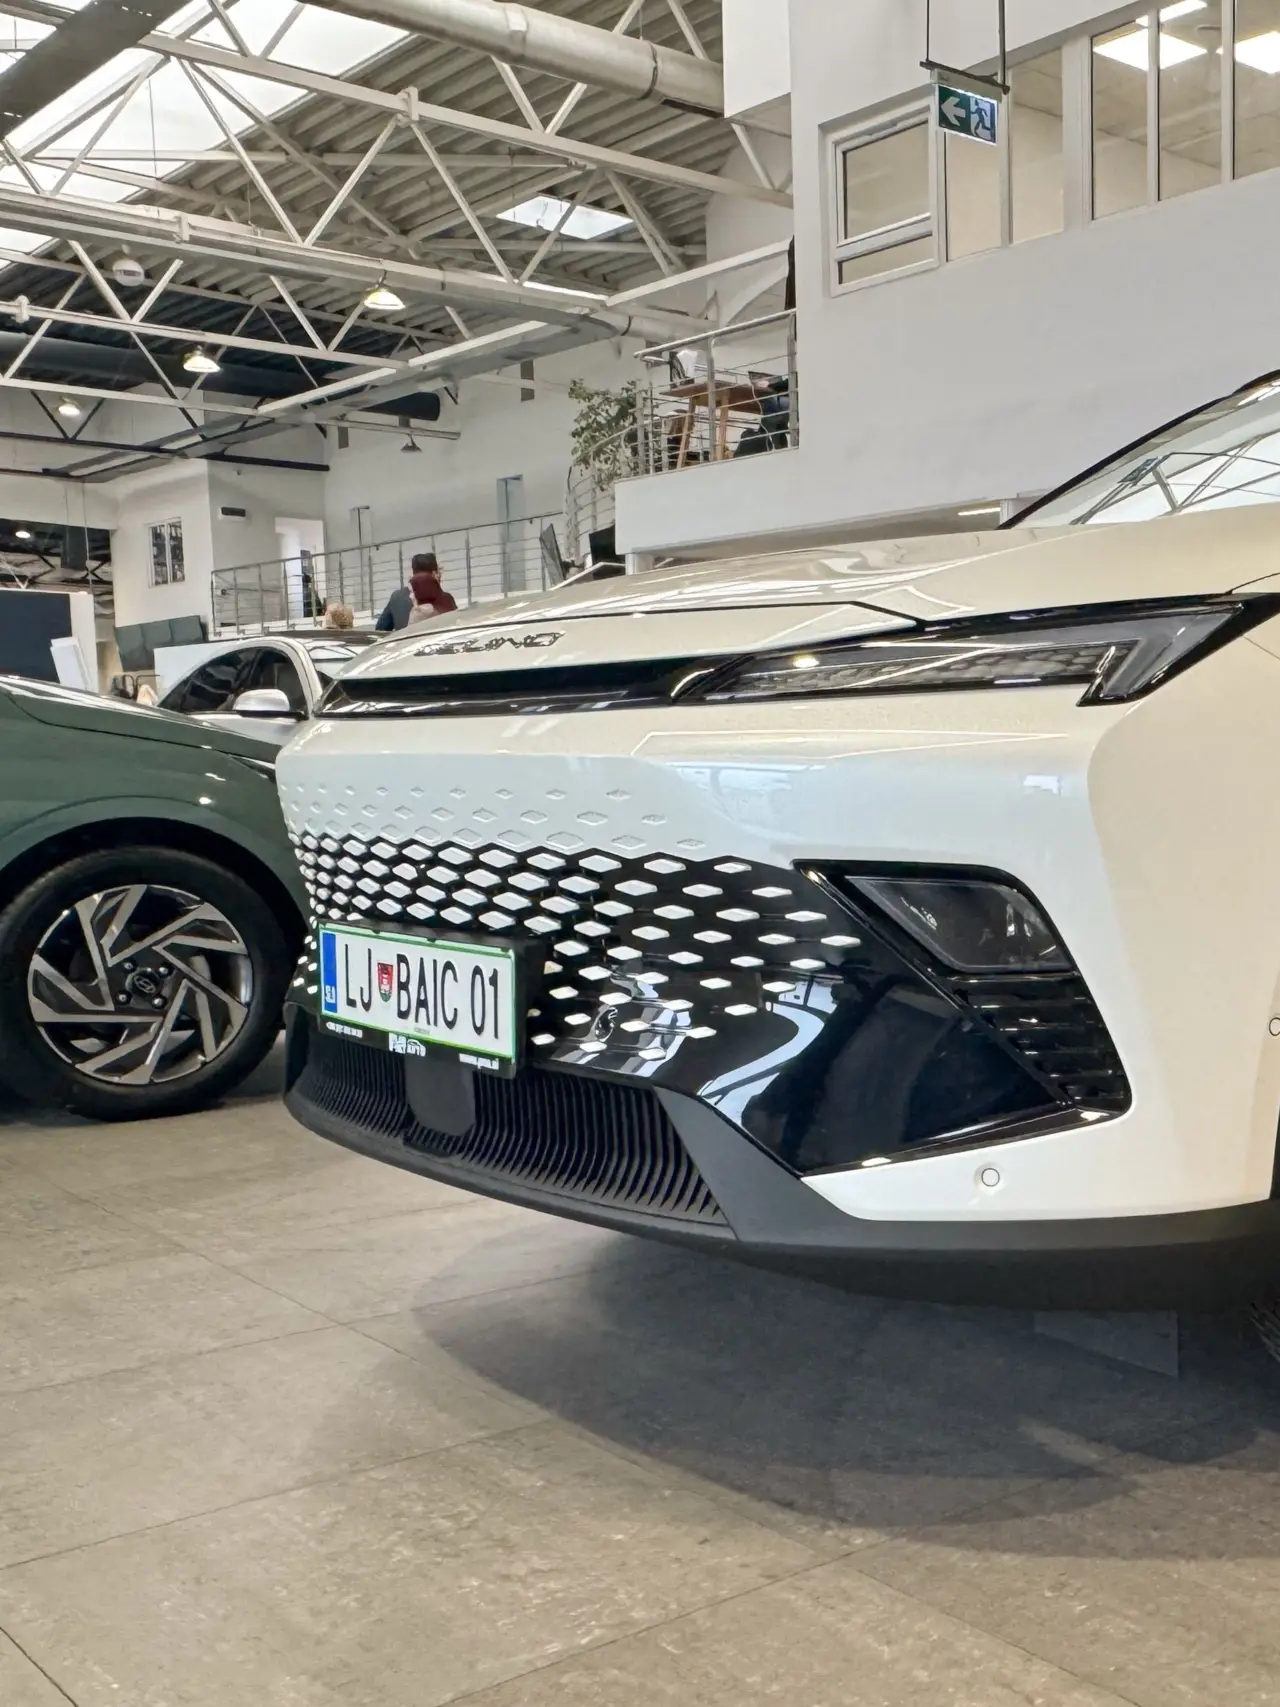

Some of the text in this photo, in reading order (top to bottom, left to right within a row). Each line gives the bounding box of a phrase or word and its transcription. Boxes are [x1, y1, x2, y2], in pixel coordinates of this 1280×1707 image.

[345, 944, 499, 1040] LJ BAIC 01
